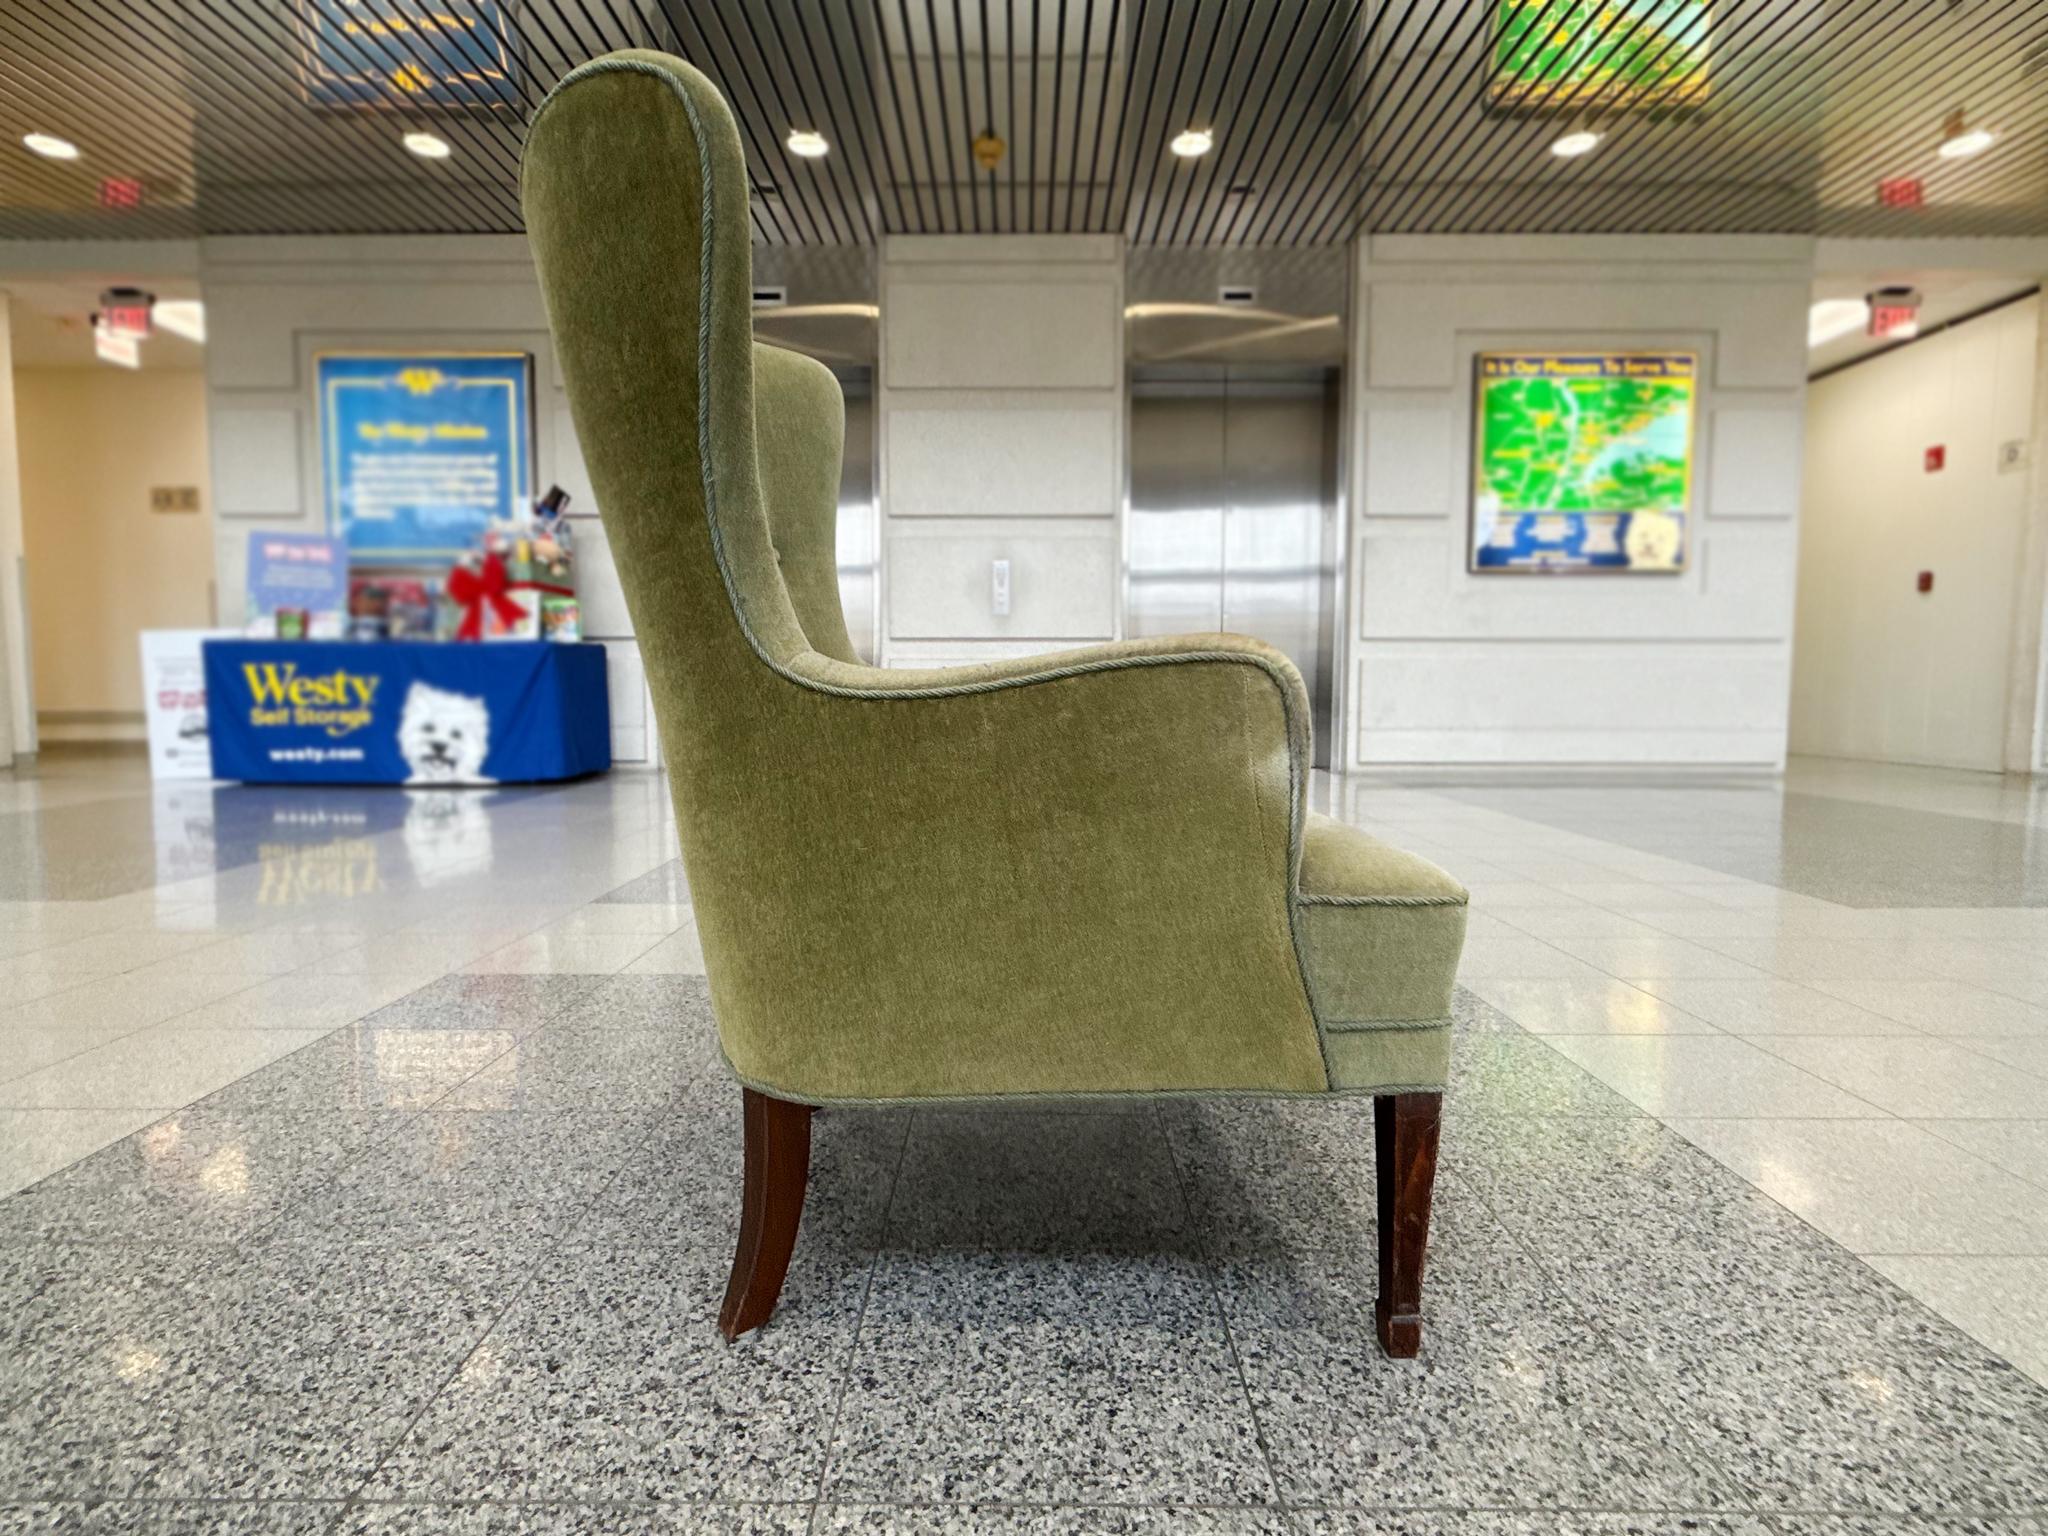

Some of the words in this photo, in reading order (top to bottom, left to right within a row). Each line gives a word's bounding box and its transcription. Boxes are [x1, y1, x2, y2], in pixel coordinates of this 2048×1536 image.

[242, 662, 380, 709] Westy
[250, 706, 289, 726] Self
[294, 705, 372, 737] Storage
[268, 747, 365, 764] westy.com
